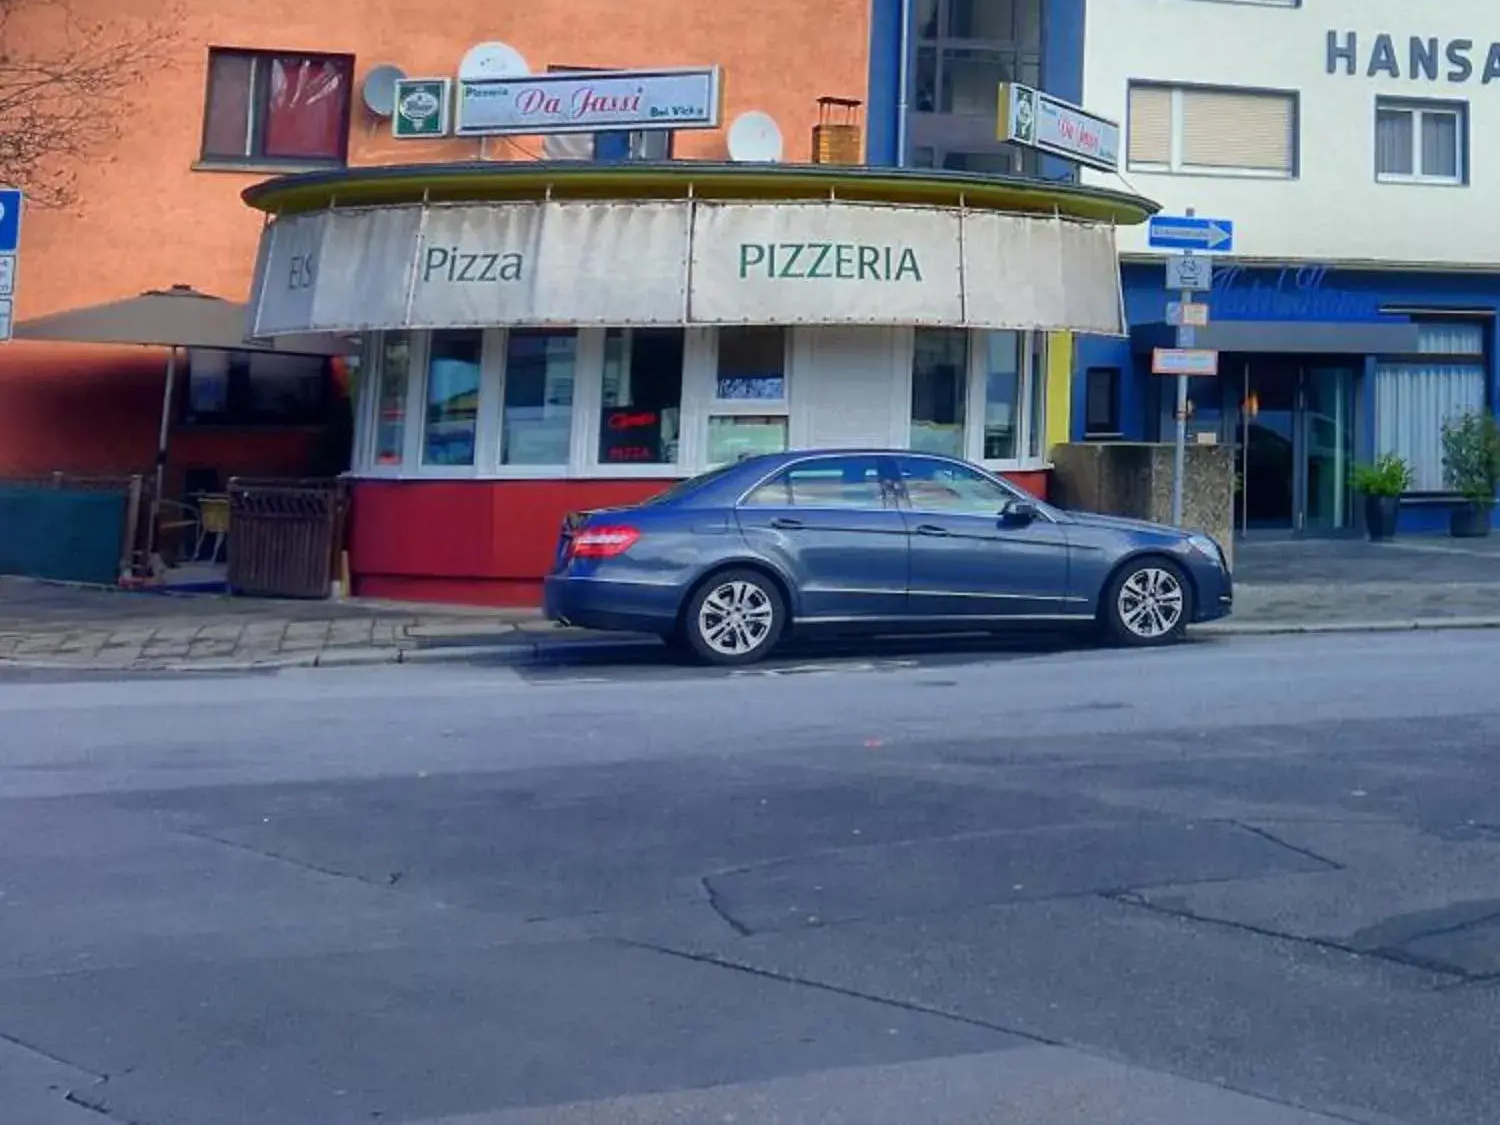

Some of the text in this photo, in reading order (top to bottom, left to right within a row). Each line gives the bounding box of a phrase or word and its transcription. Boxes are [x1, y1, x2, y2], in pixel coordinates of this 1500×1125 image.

[515, 88, 561, 115] Da
[424, 246, 522, 282] Pizza
[739, 243, 922, 282] PIZZERIA
